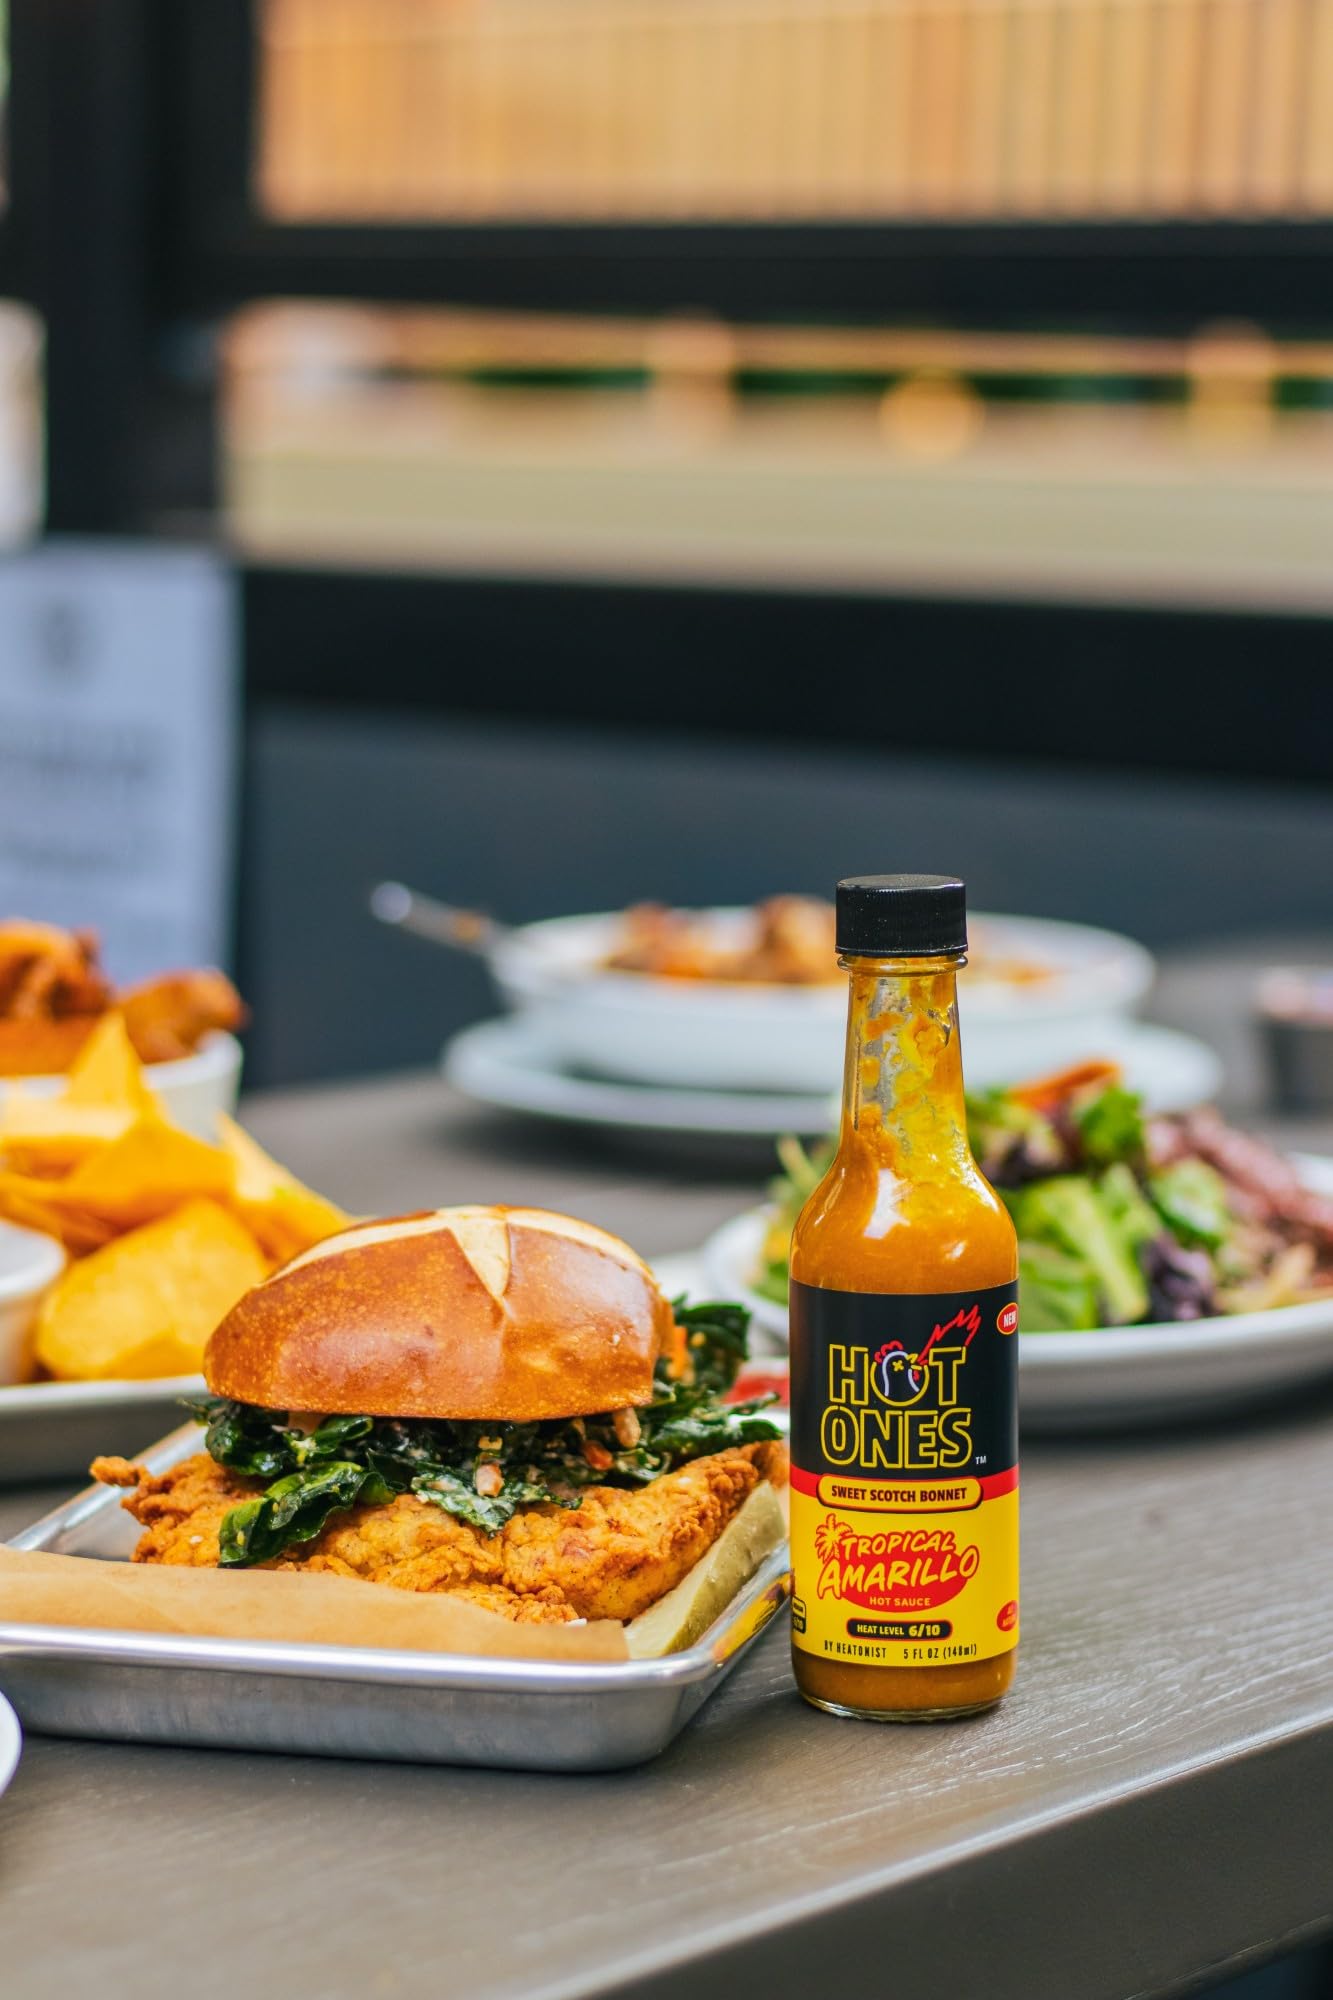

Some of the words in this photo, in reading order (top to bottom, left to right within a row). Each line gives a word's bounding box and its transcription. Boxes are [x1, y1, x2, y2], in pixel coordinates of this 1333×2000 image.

[829, 1344, 967, 1407] HOT
[820, 1405, 973, 1469] ONES
[831, 1485, 867, 1500] SWEET
[870, 1488, 916, 1502] SCOTCH
[920, 1487, 967, 1502] BONNET
[841, 1532, 955, 1561] TROPICAL
[818, 1545, 979, 1599] AMARILLO
[869, 1596, 892, 1606] HOT
[895, 1597, 931, 1607] SAUCE
[857, 1624, 877, 1635] HEAT
[879, 1625, 904, 1636] LEVEL
[908, 1623, 941, 1638] 6/10
[824, 1640, 834, 1652] BY
[836, 1641, 887, 1659] HEATONIST
[903, 1648, 909, 1660] 5
[913, 1647, 923, 1659] FL
[928, 1646, 939, 1659] OZ
[943, 1643, 977, 1660] (148ml)
